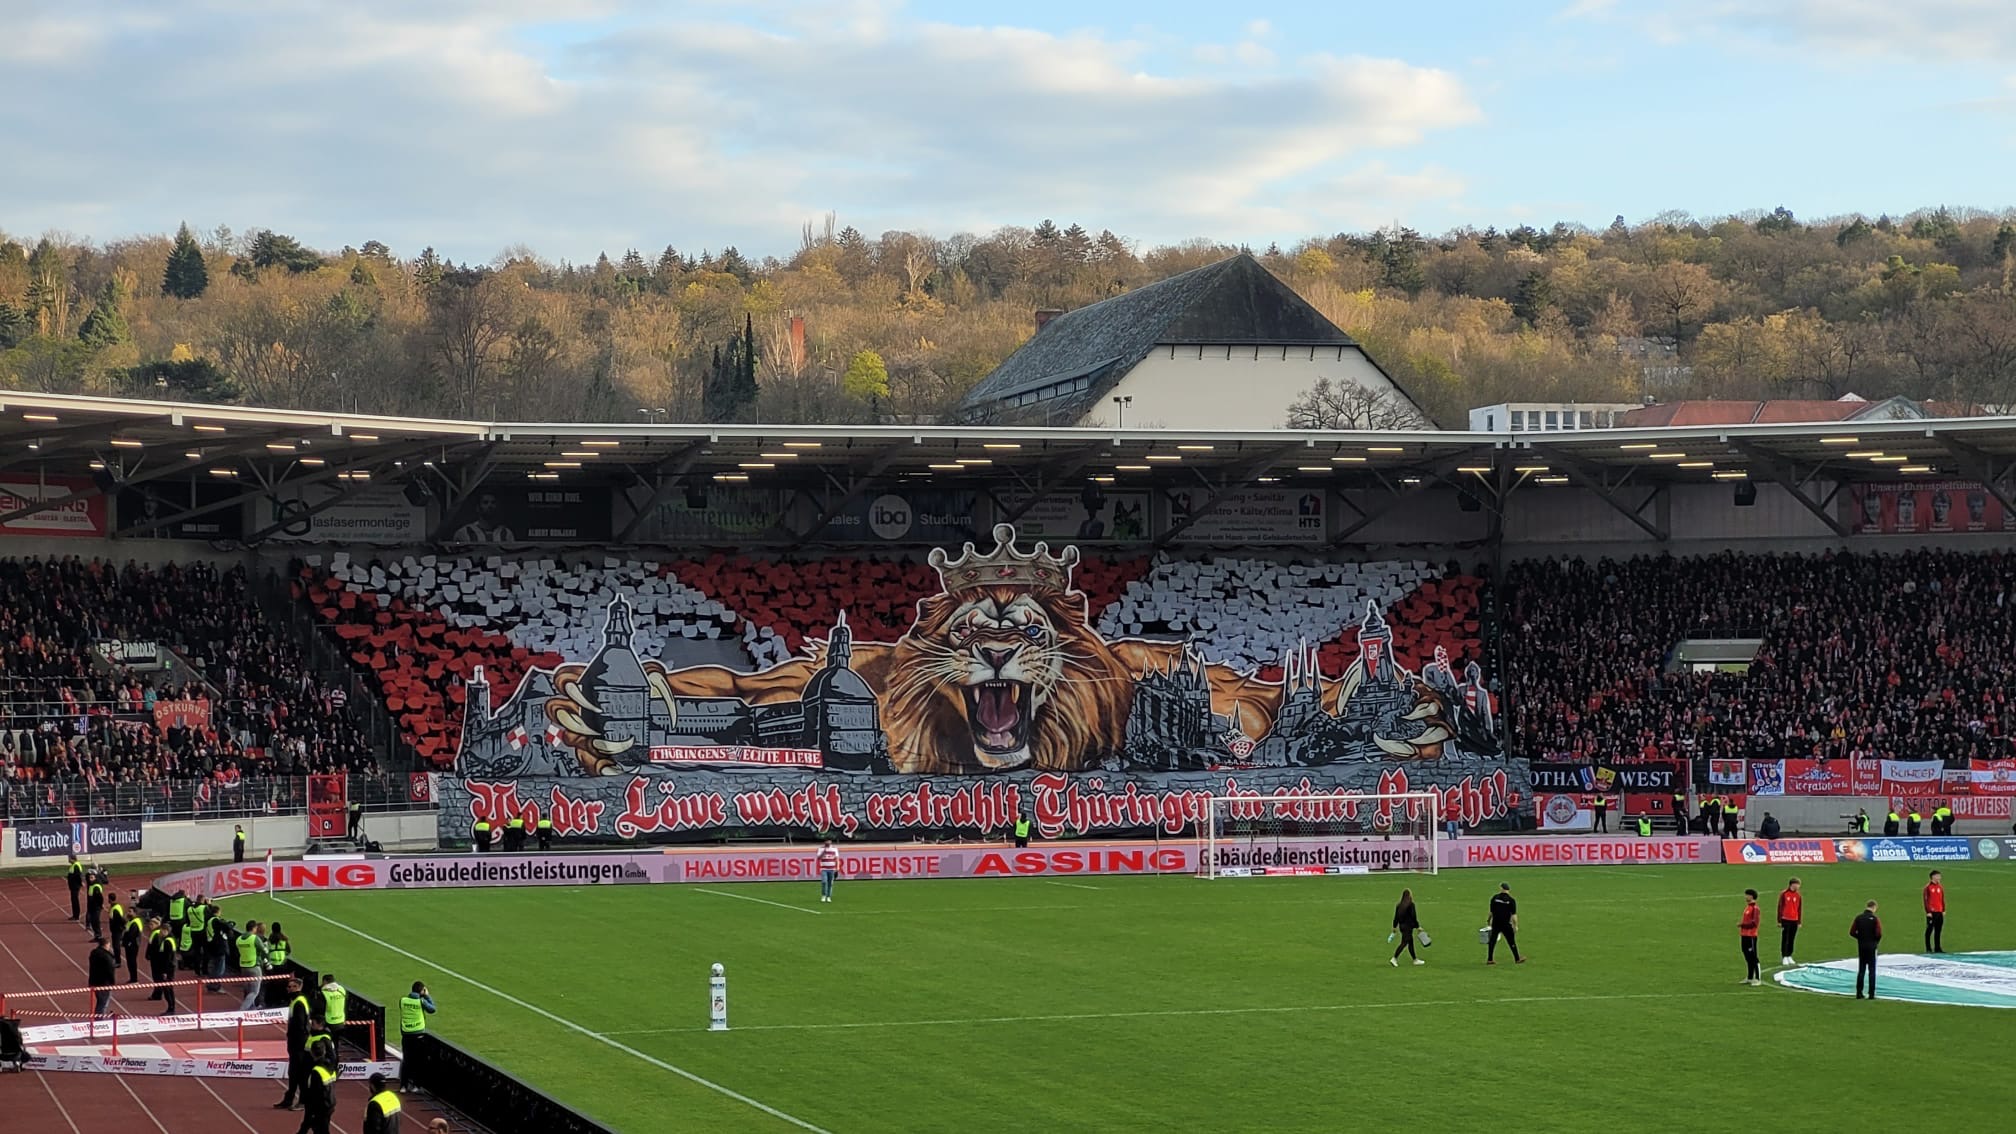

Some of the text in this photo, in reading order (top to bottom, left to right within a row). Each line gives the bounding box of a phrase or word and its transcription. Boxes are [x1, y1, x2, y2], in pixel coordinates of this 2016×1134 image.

[875, 506, 906, 525] iba
[919, 513, 971, 526] Studium
[1298, 518, 1319, 528] HTS
[155, 703, 207, 719] OSTKURVE
[652, 748, 820, 763] THÜRINGENS ECHTE LIEBE
[1856, 760, 1877, 770] RWE
[1529, 771, 1673, 787] OTHA WEST
[551, 785, 605, 837] der
[613, 775, 727, 839] Löwe
[732, 780, 858, 838] wacht,
[867, 781, 1020, 835] erstrahlt
[1031, 773, 1213, 838] Thüringen
[1225, 777, 1264, 822] in
[1272, 777, 1364, 823] seiner
[1952, 799, 1972, 814] ROT
[1976, 799, 2009, 815] WEISS
[19, 827, 140, 852] Brigade Weimar
[213, 866, 375, 893] ASSING
[390, 863, 622, 883] Gebäudedienstleistungen
[973, 850, 1164, 874] ASSING
[1199, 847, 1410, 867] Gebäudedienstleistungen
[1468, 842, 1699, 862] HAUSMEISTERDIENSTE
[103, 1057, 147, 1068] NextPhones
[207, 1061, 253, 1072] NextPhones
[337, 1064, 366, 1074] Phones
